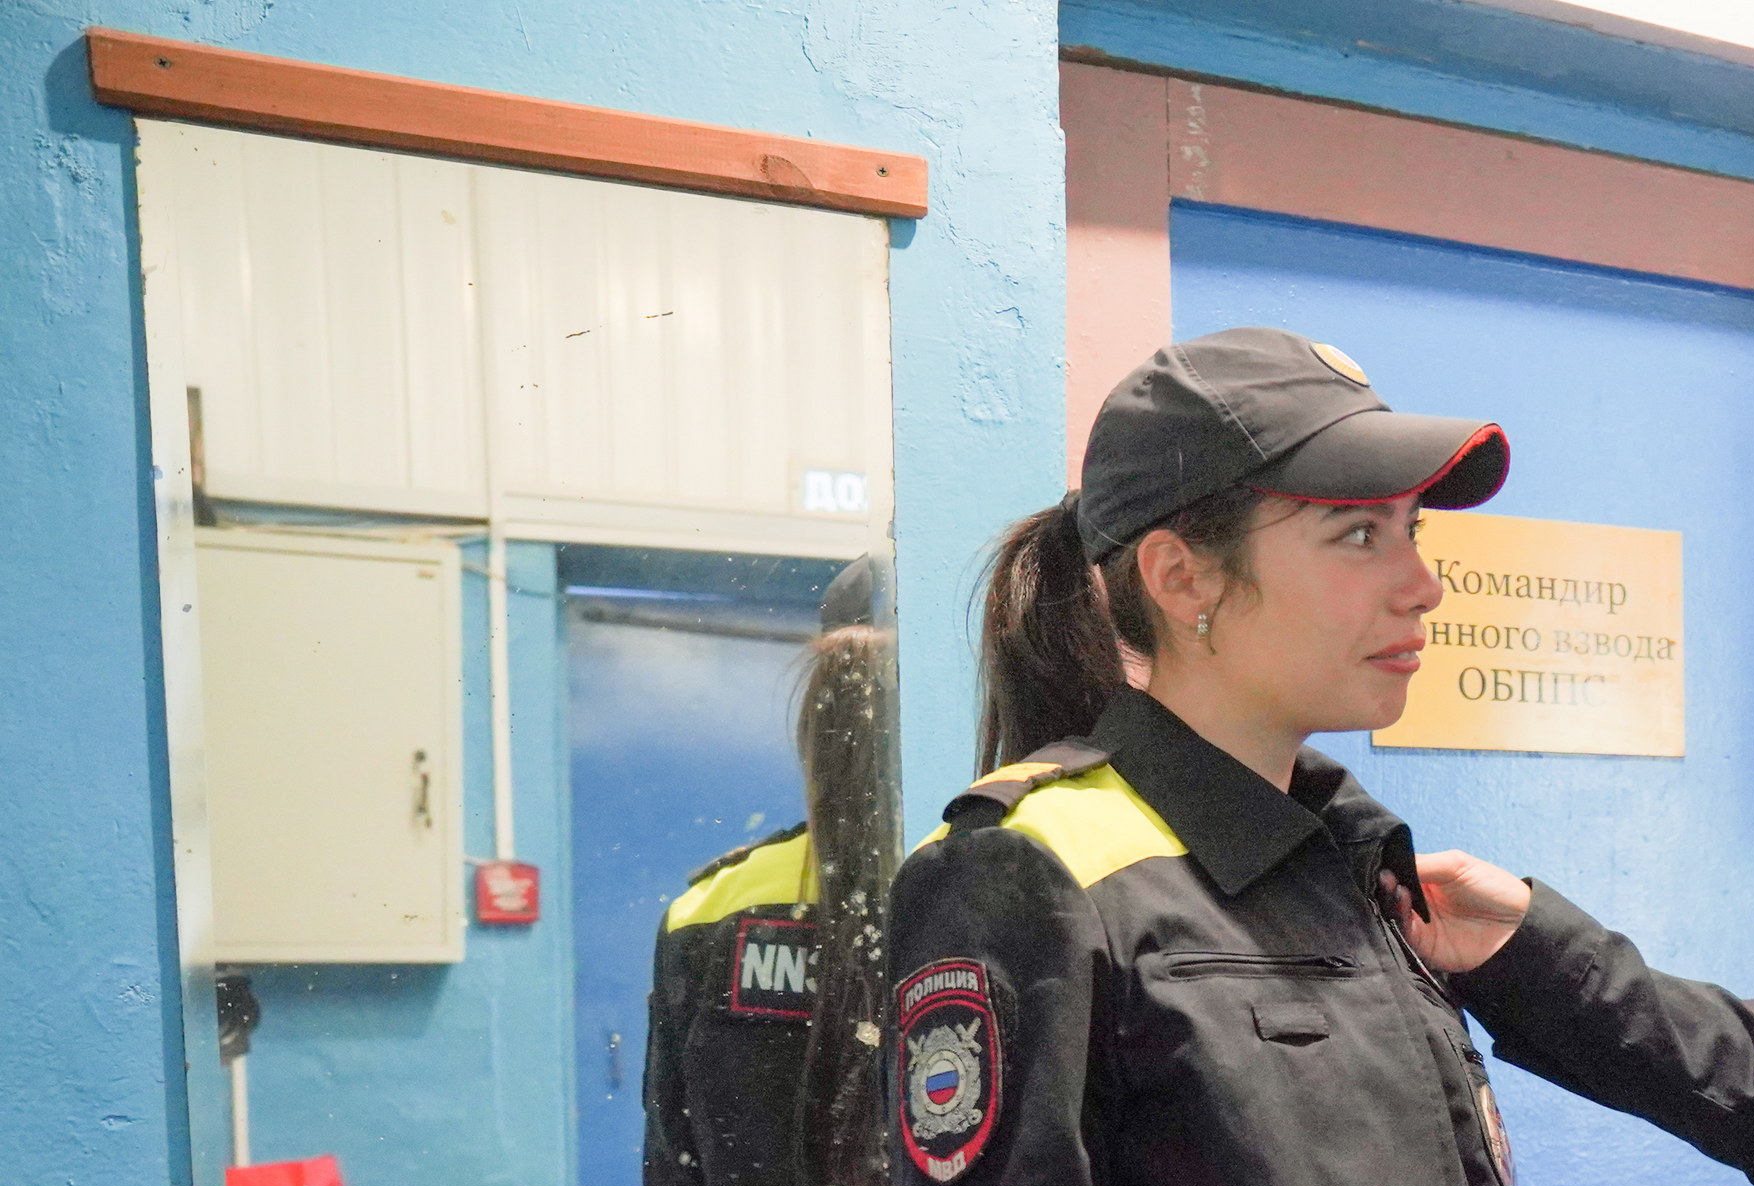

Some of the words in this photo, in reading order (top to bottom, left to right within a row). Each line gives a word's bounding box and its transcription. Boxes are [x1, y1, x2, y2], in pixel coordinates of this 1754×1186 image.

[1433, 558, 1628, 616] Командир
[1429, 620, 1542, 653] нного
[1553, 628, 1676, 664] взвода
[1458, 666, 1608, 709] ОБППС
[905, 970, 980, 1012] ПОЛИЦИЯ
[927, 1150, 967, 1182] МВД
